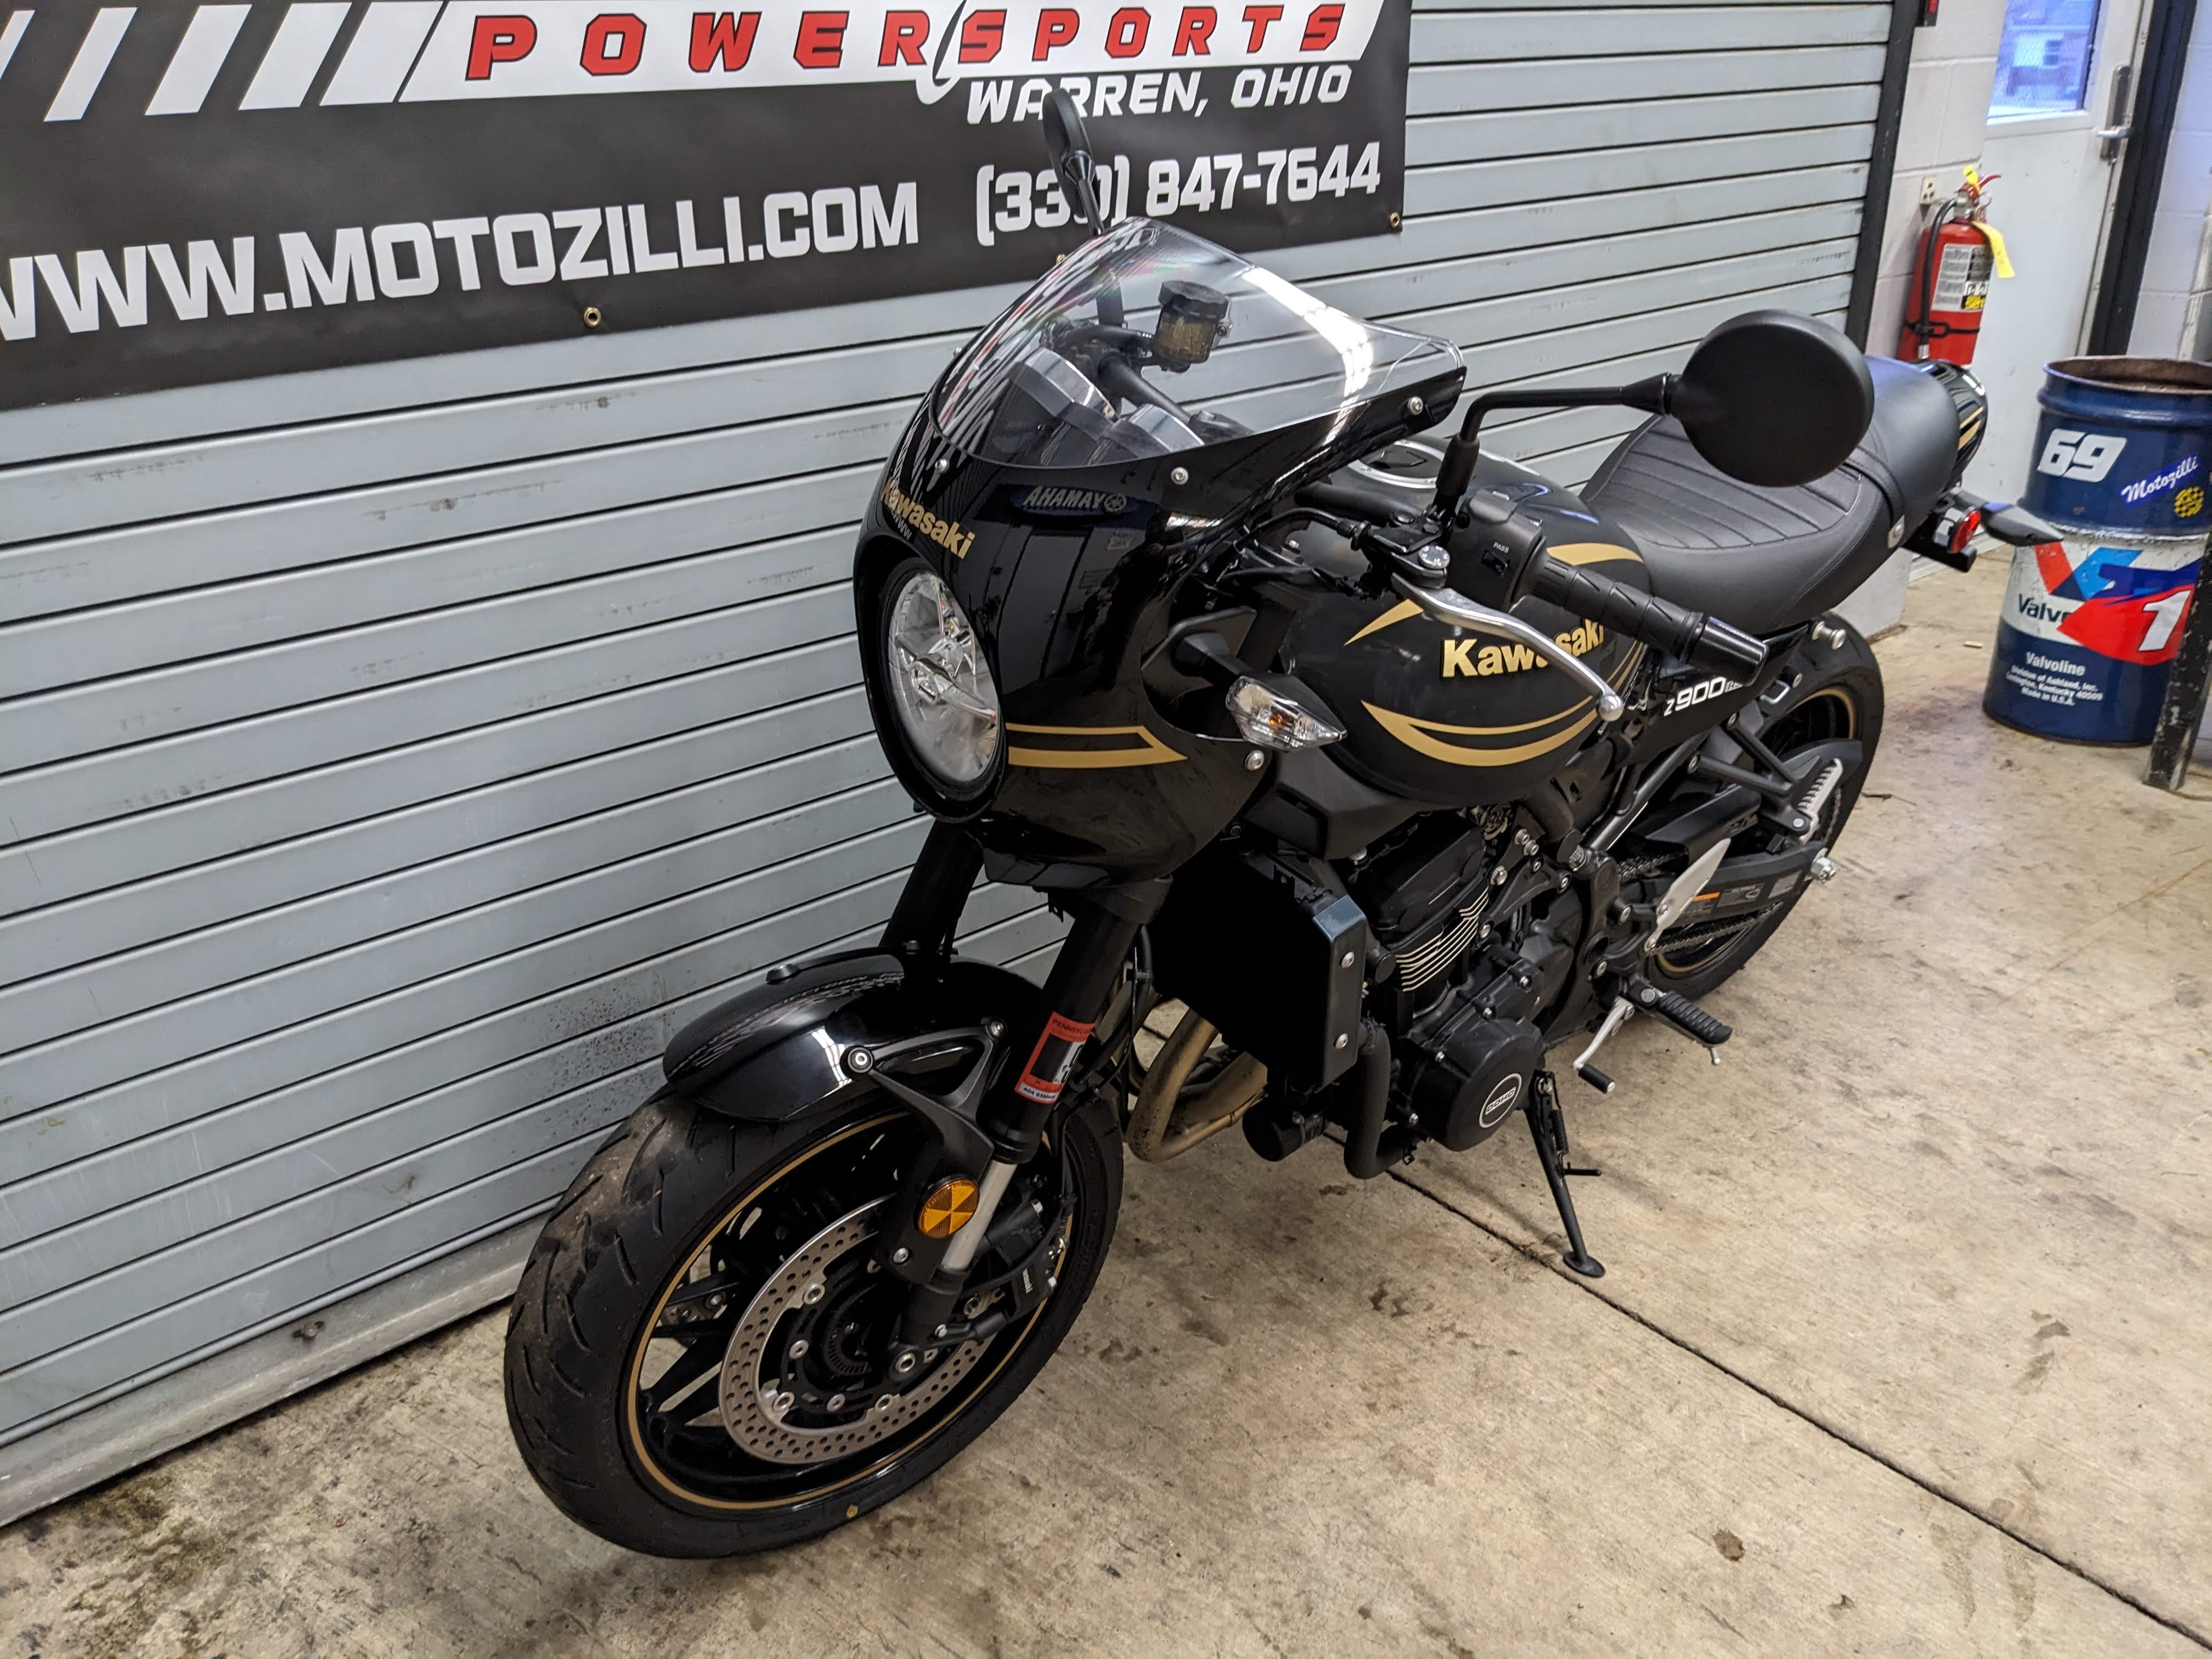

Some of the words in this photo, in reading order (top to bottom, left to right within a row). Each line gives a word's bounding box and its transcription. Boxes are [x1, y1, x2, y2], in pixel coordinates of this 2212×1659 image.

[967, 72, 1208, 125] WARREN,
[1231, 64, 1352, 109] OHIO
[1146, 143, 1381, 217] 847-7644
[2038, 428, 2126, 482] 69
[2121, 456, 2199, 503] Motozilli
[880, 476, 975, 559] Kawasaki
[1442, 618, 1604, 678] Kawsaki
[2138, 590, 2192, 651] 1
[2025, 651, 2086, 676] Valvoline
